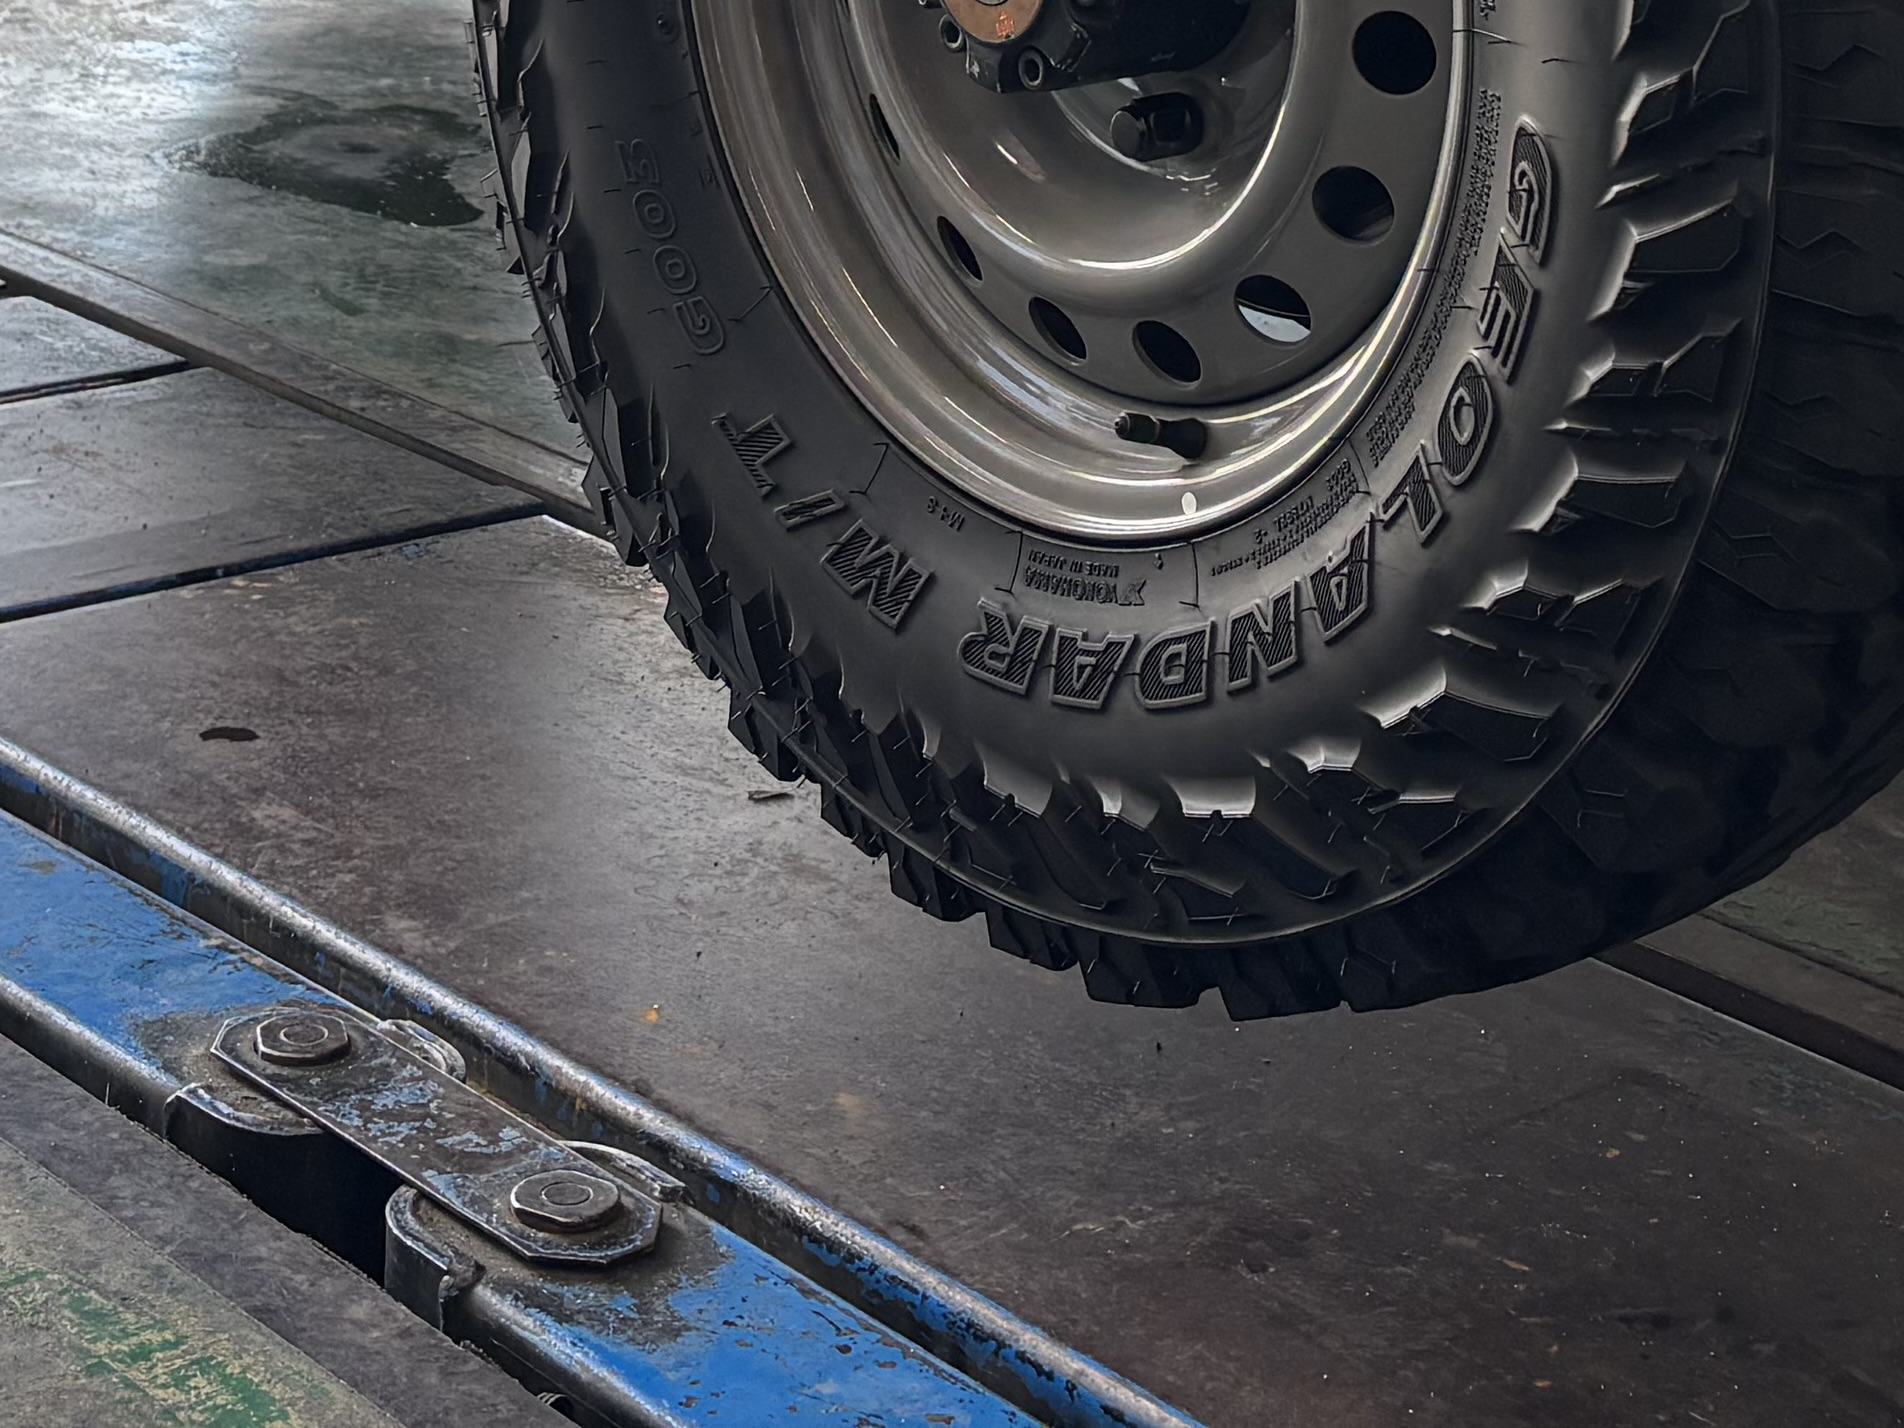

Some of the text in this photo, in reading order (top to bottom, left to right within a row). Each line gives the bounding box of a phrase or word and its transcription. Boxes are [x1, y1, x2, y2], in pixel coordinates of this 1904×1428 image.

[961, 116, 1550, 709] GEOLANDAR
[712, 413, 935, 629] M/T
[1022, 563, 1118, 605] YOKOHAMA
[1027, 545, 1067, 573] JAPAN
